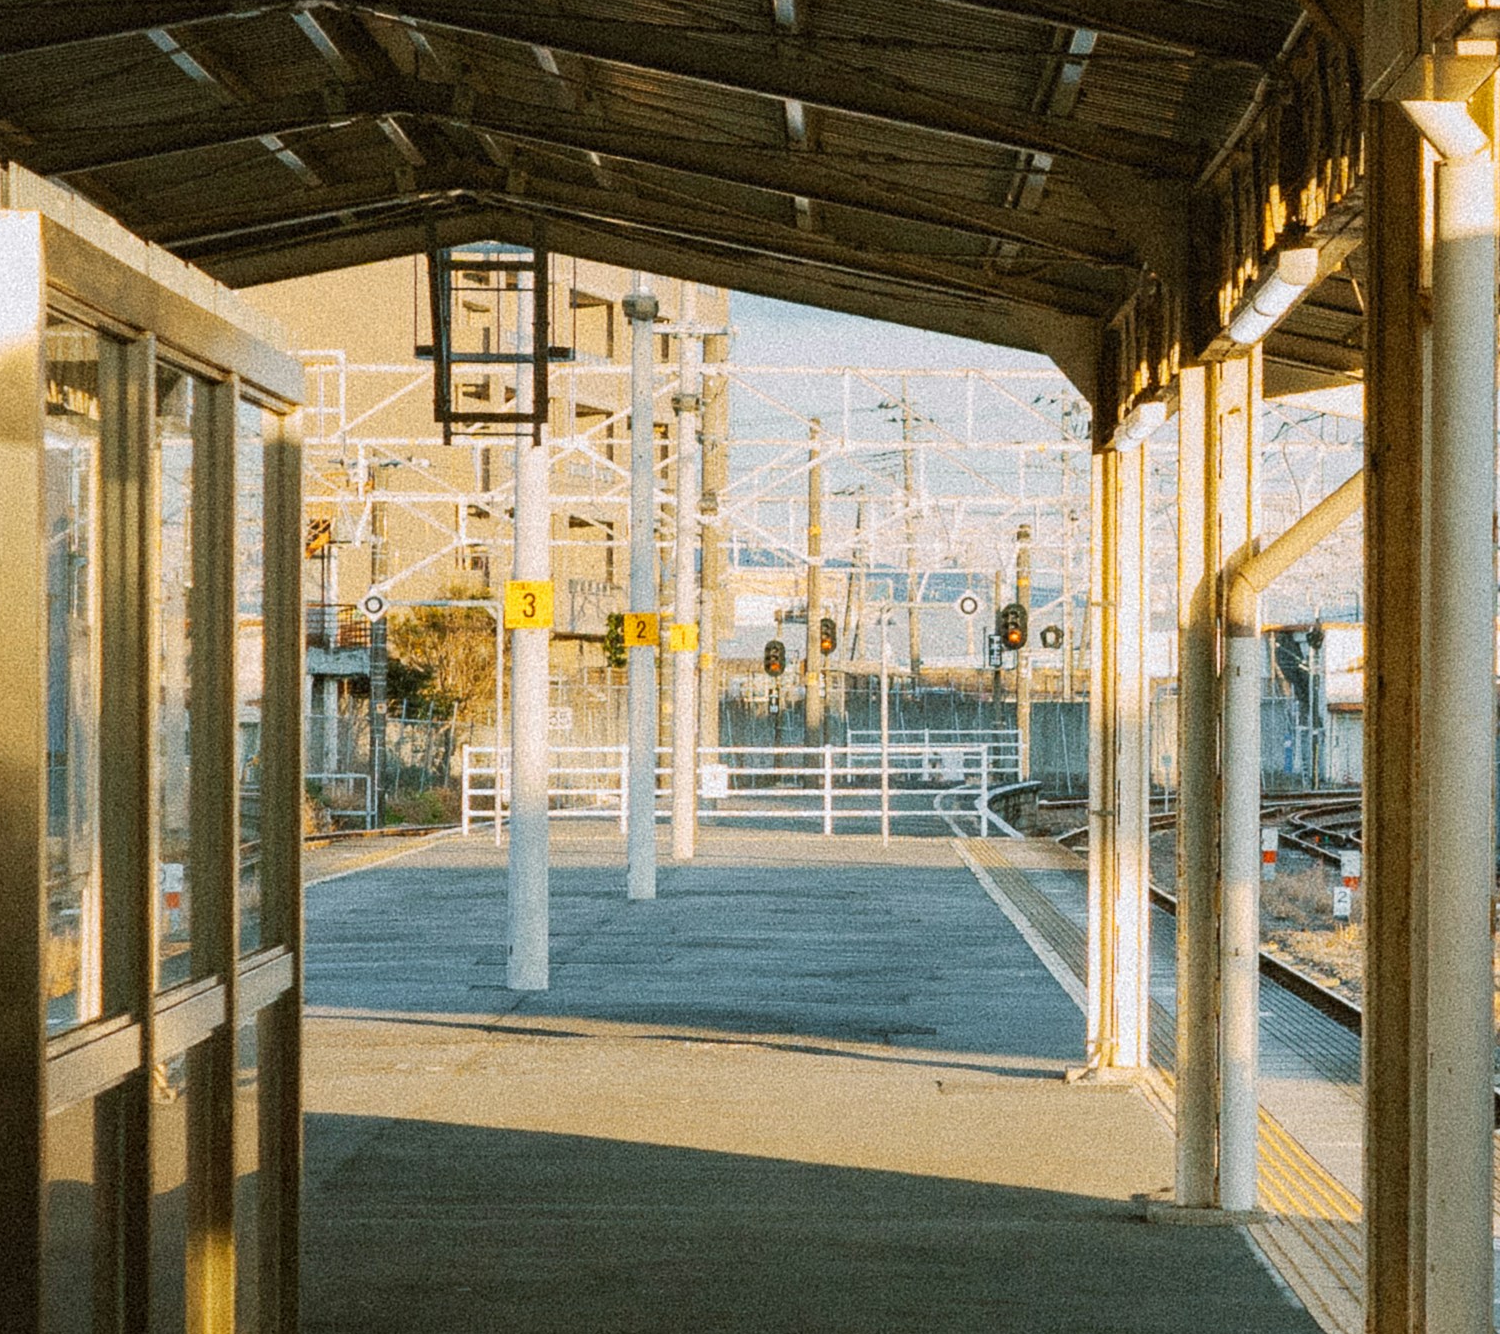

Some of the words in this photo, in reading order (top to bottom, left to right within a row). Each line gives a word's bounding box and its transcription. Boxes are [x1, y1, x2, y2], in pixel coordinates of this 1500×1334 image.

[523, 592, 536, 618] 3
[636, 620, 647, 639] 2
[1337, 890, 1348, 904] 2
